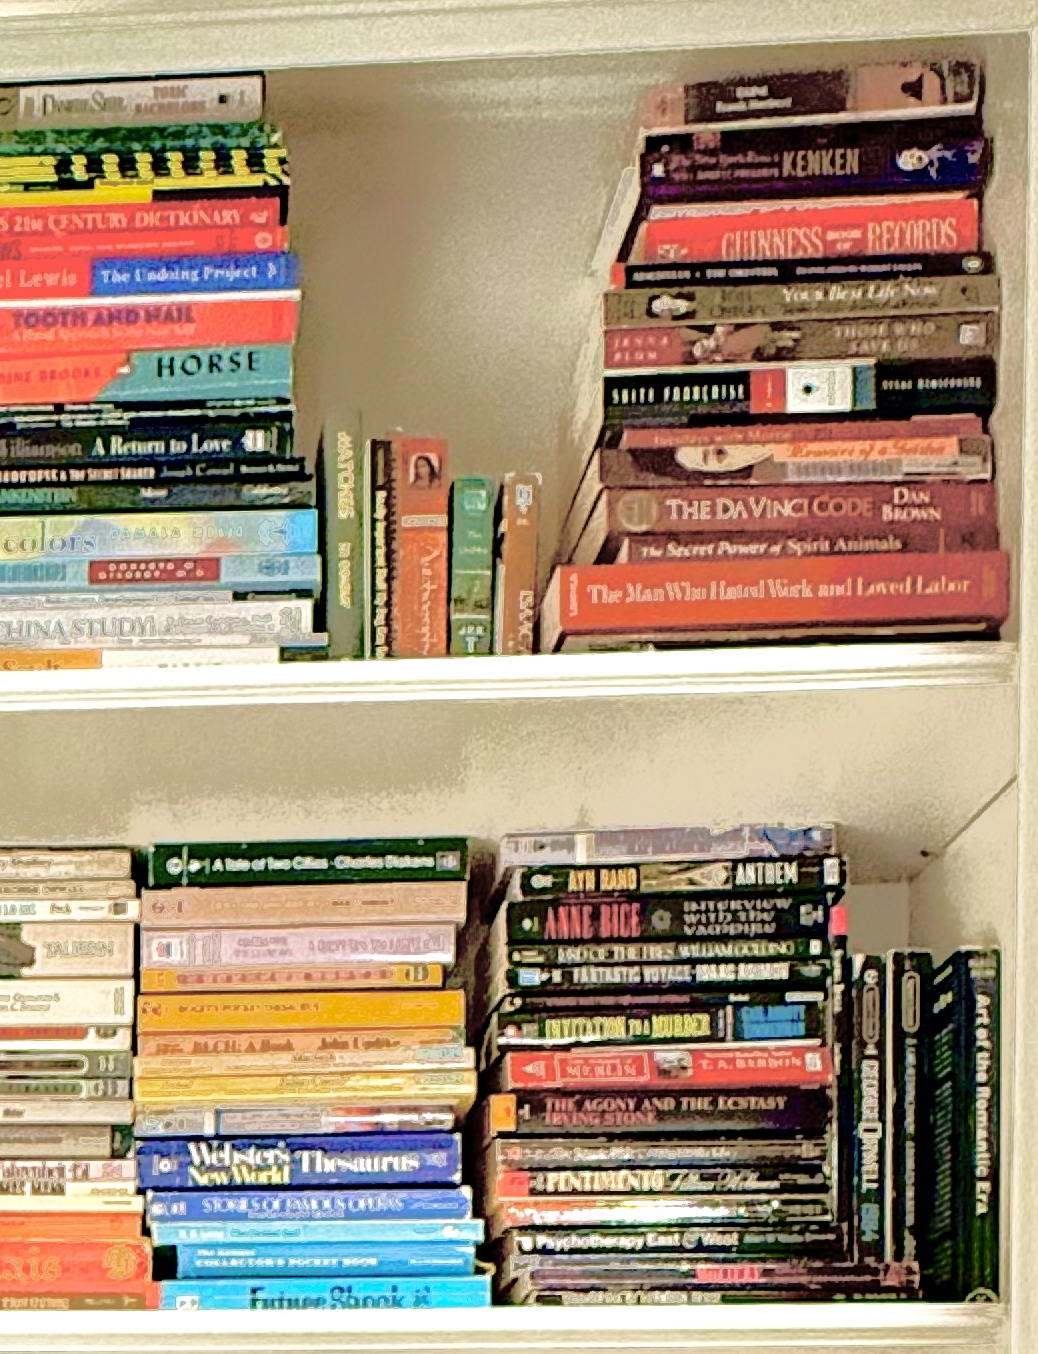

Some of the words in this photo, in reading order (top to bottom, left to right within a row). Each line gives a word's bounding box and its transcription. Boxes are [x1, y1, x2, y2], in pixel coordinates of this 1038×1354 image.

[867, 219, 957, 252] RECORDS
[20, 269, 77, 287] Lewis
[13, 310, 90, 329] TOOTH
[93, 309, 140, 326] AND
[157, 352, 262, 377] HORSE
[192, 433, 232, 452] Love
[893, 488, 930, 504] DAN
[666, 499, 710, 520] THE
[749, 497, 809, 518] VINCI
[813, 496, 872, 516] CODE
[882, 505, 941, 522] BROWN
[2, 520, 95, 552] colors
[584, 1098, 637, 1110] AGONY
[642, 1097, 675, 1110] AND
[680, 1096, 714, 1110] THE
